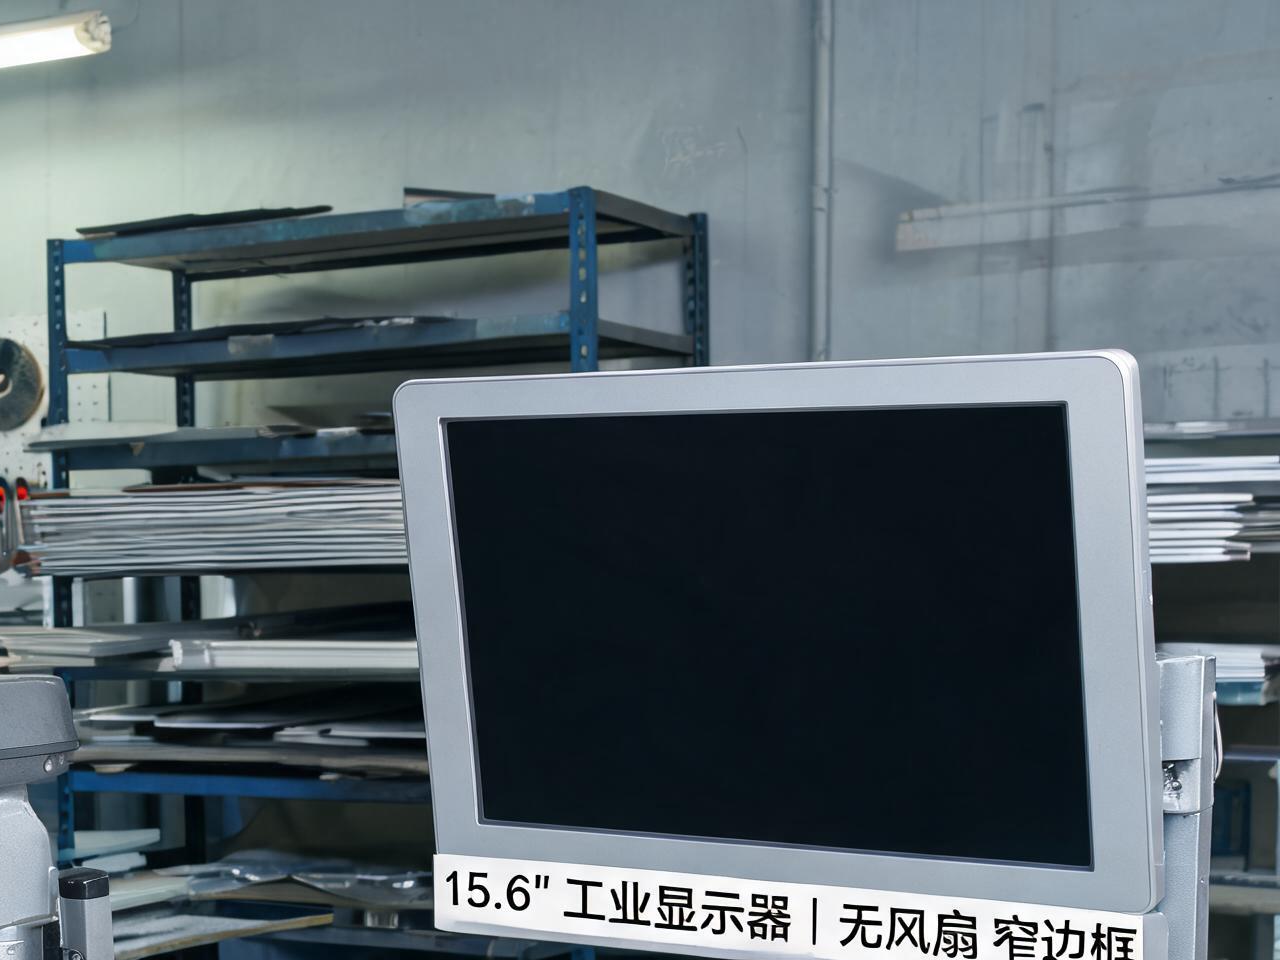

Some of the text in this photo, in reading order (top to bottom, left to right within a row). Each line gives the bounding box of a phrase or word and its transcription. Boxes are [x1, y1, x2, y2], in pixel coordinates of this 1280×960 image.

[445, 870, 550, 912] 15.6"
[563, 878, 791, 943] 工业显示器
[839, 904, 978, 960] 无风扇
